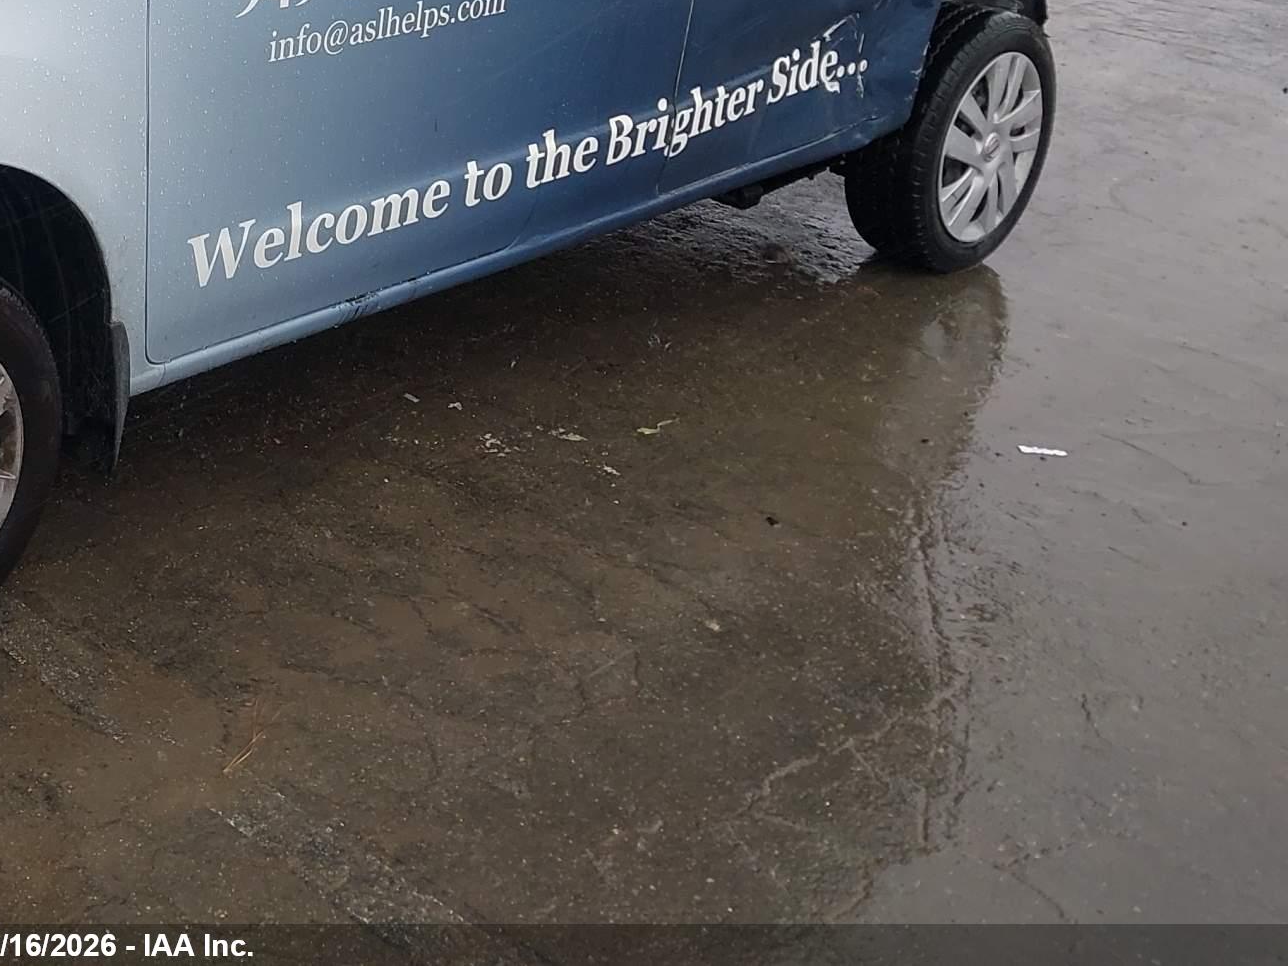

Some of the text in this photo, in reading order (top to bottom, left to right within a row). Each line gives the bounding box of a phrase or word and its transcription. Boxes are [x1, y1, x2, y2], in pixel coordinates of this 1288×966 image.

[187, 40, 868, 289] Welcome to the Brighter Side...
